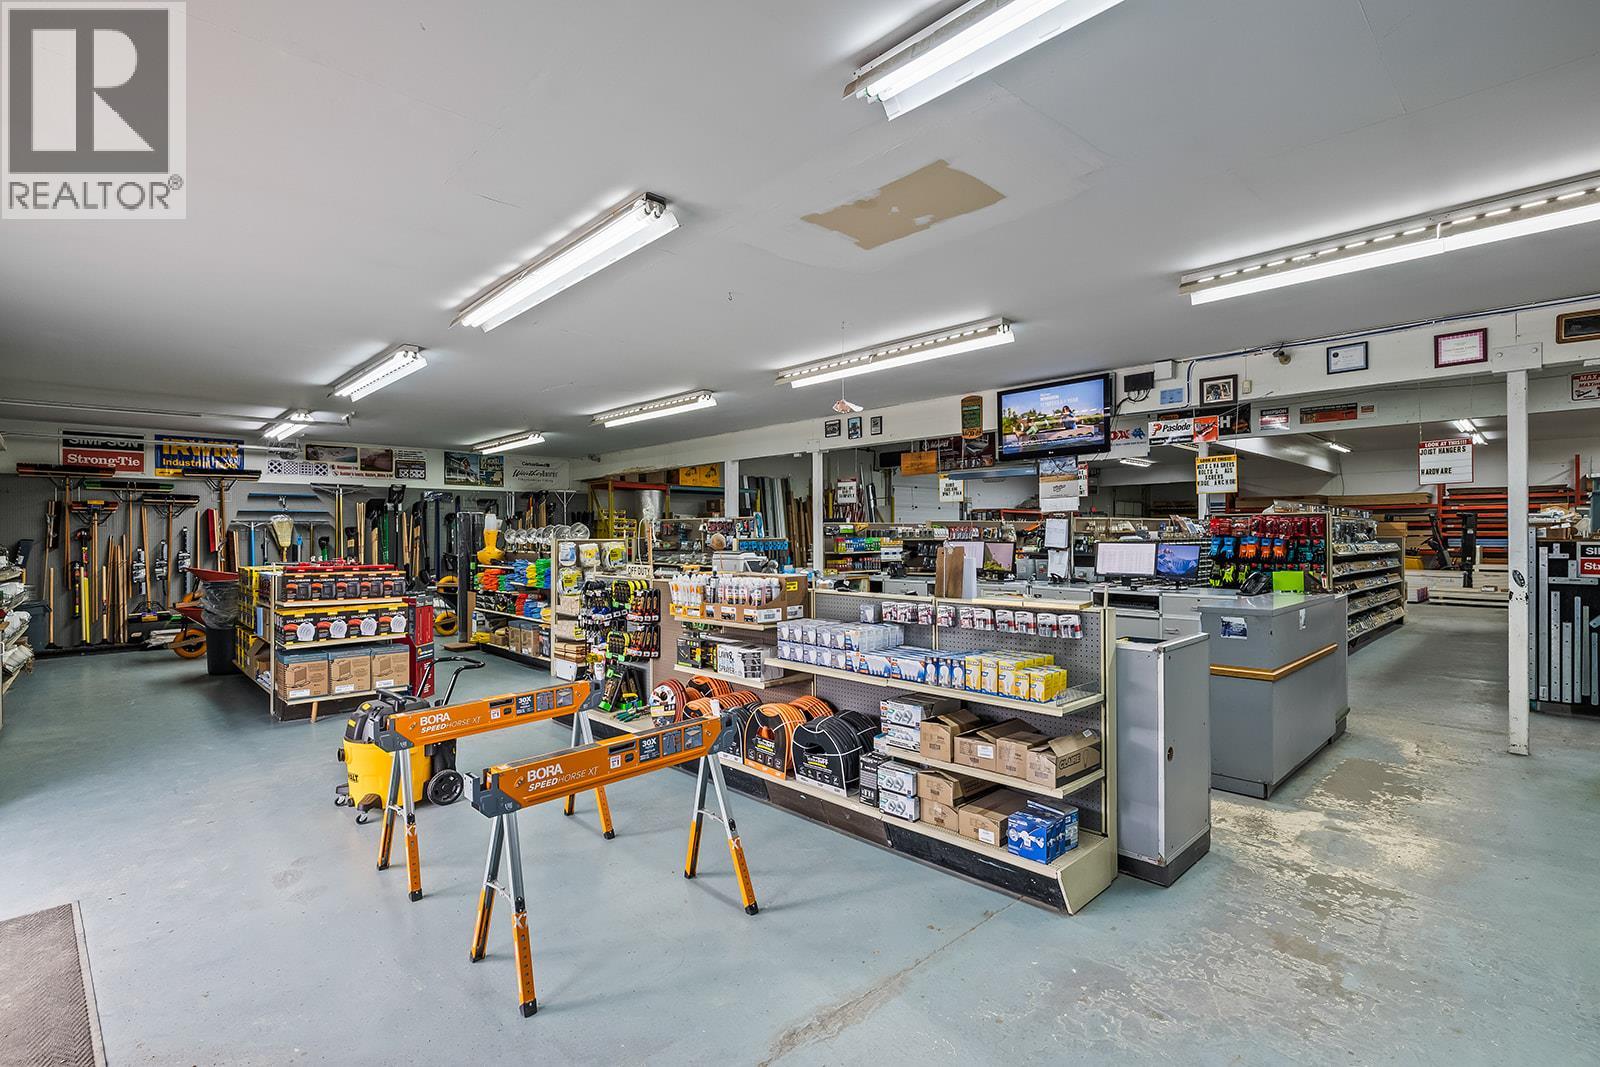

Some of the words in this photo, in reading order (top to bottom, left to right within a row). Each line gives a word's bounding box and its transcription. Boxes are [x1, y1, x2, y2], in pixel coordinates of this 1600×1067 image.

[1162, 422, 1190, 433] Paslode
[1420, 448, 1436, 456] JOIST
[1438, 446, 1466, 455] HANGERS
[66, 453, 141, 468] Strong-Tie
[419, 711, 451, 726] BORA
[641, 737, 657, 748] 30X
[526, 763, 563, 783] BORA
